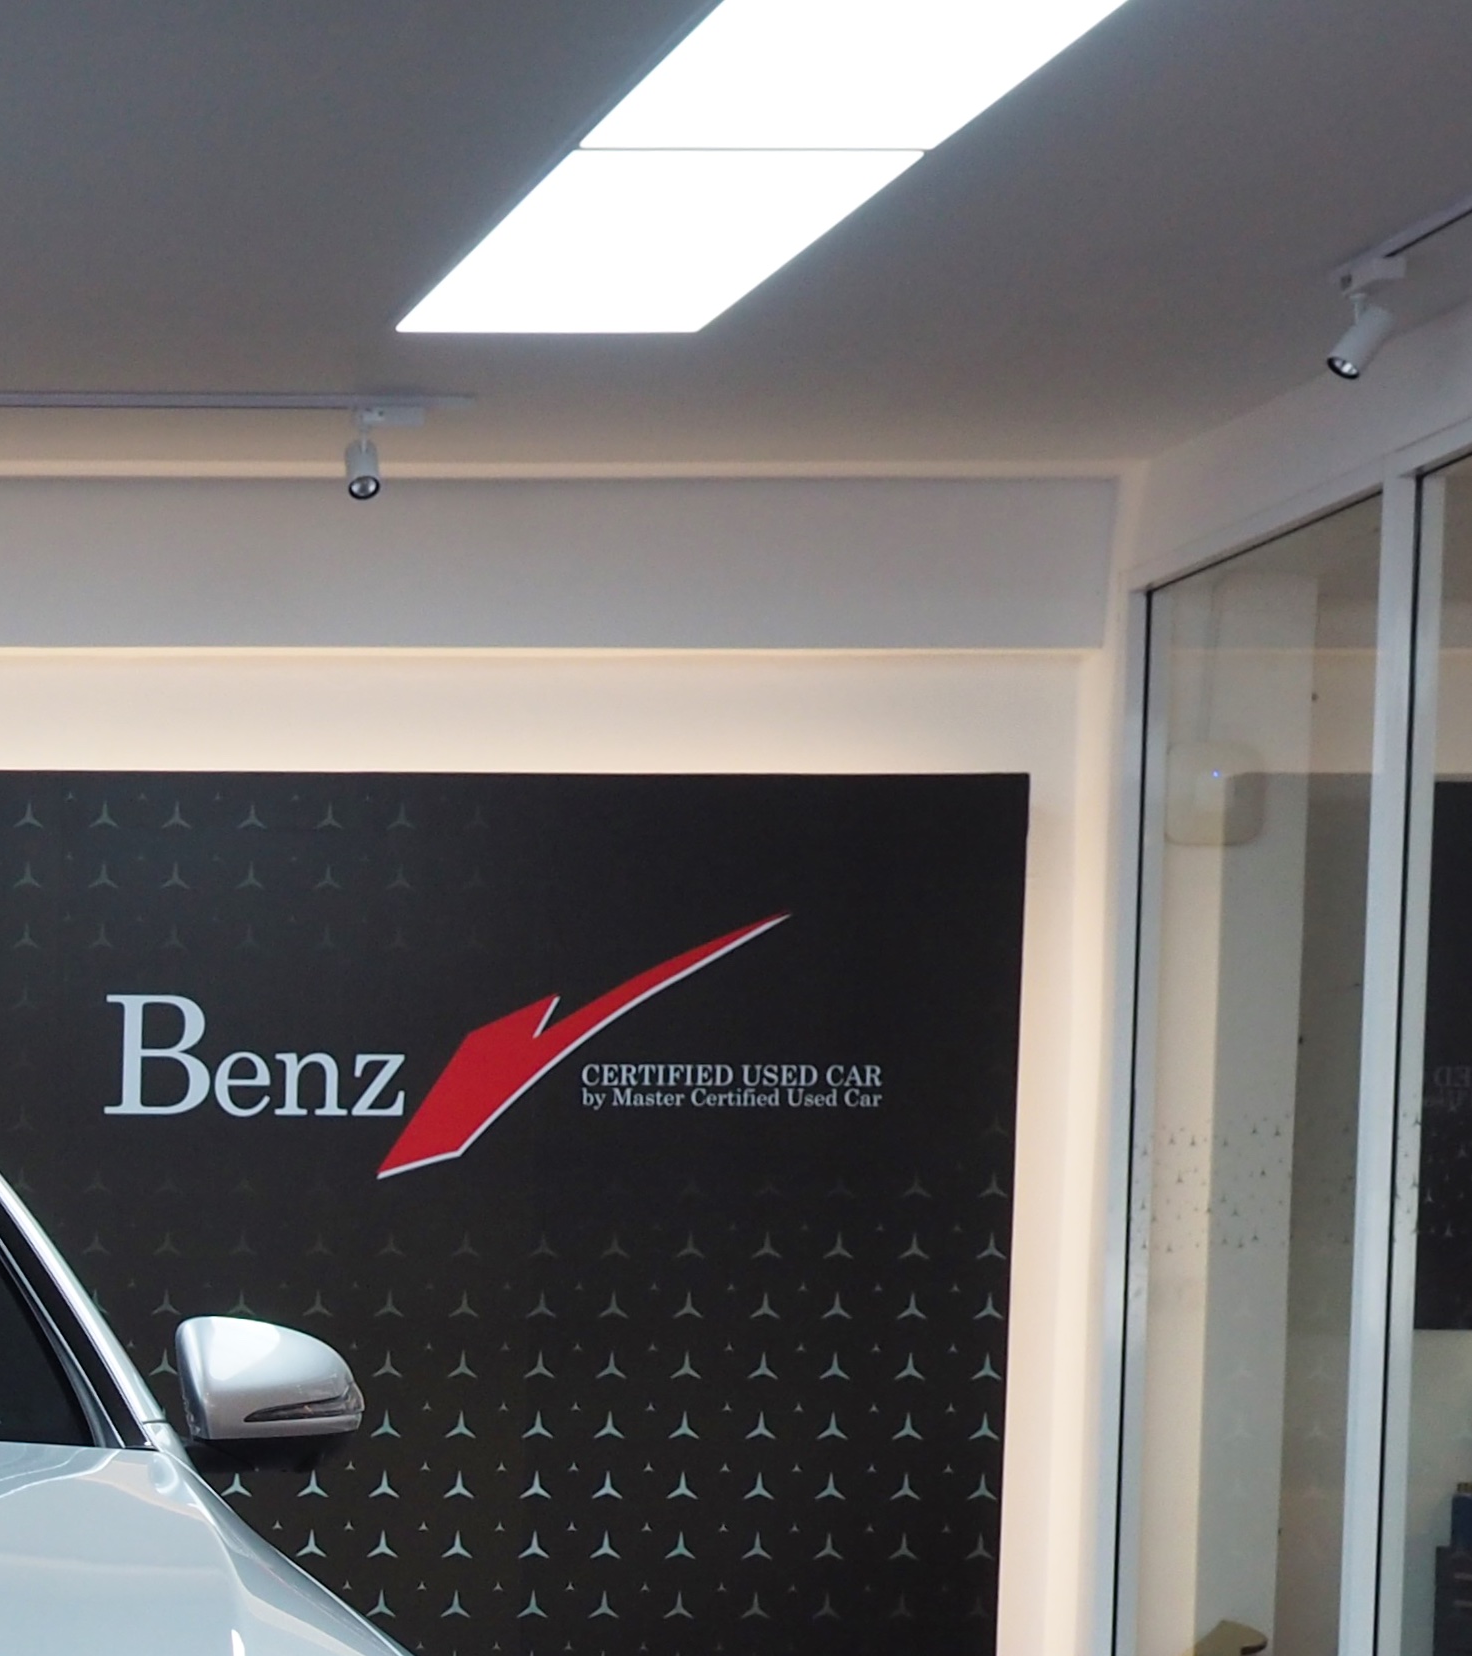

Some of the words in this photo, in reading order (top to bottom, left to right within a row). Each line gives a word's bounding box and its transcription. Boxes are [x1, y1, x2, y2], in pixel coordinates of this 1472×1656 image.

[103, 993, 406, 1118] Benz
[581, 1063, 734, 1087] CERTIFIED
[742, 1063, 818, 1087] USED
[825, 1064, 883, 1087] CAR
[582, 1088, 606, 1110] by
[612, 1088, 685, 1107] Master
[691, 1088, 780, 1108] Certified
[787, 1089, 838, 1108] Used
[844, 1089, 883, 1108] Car
